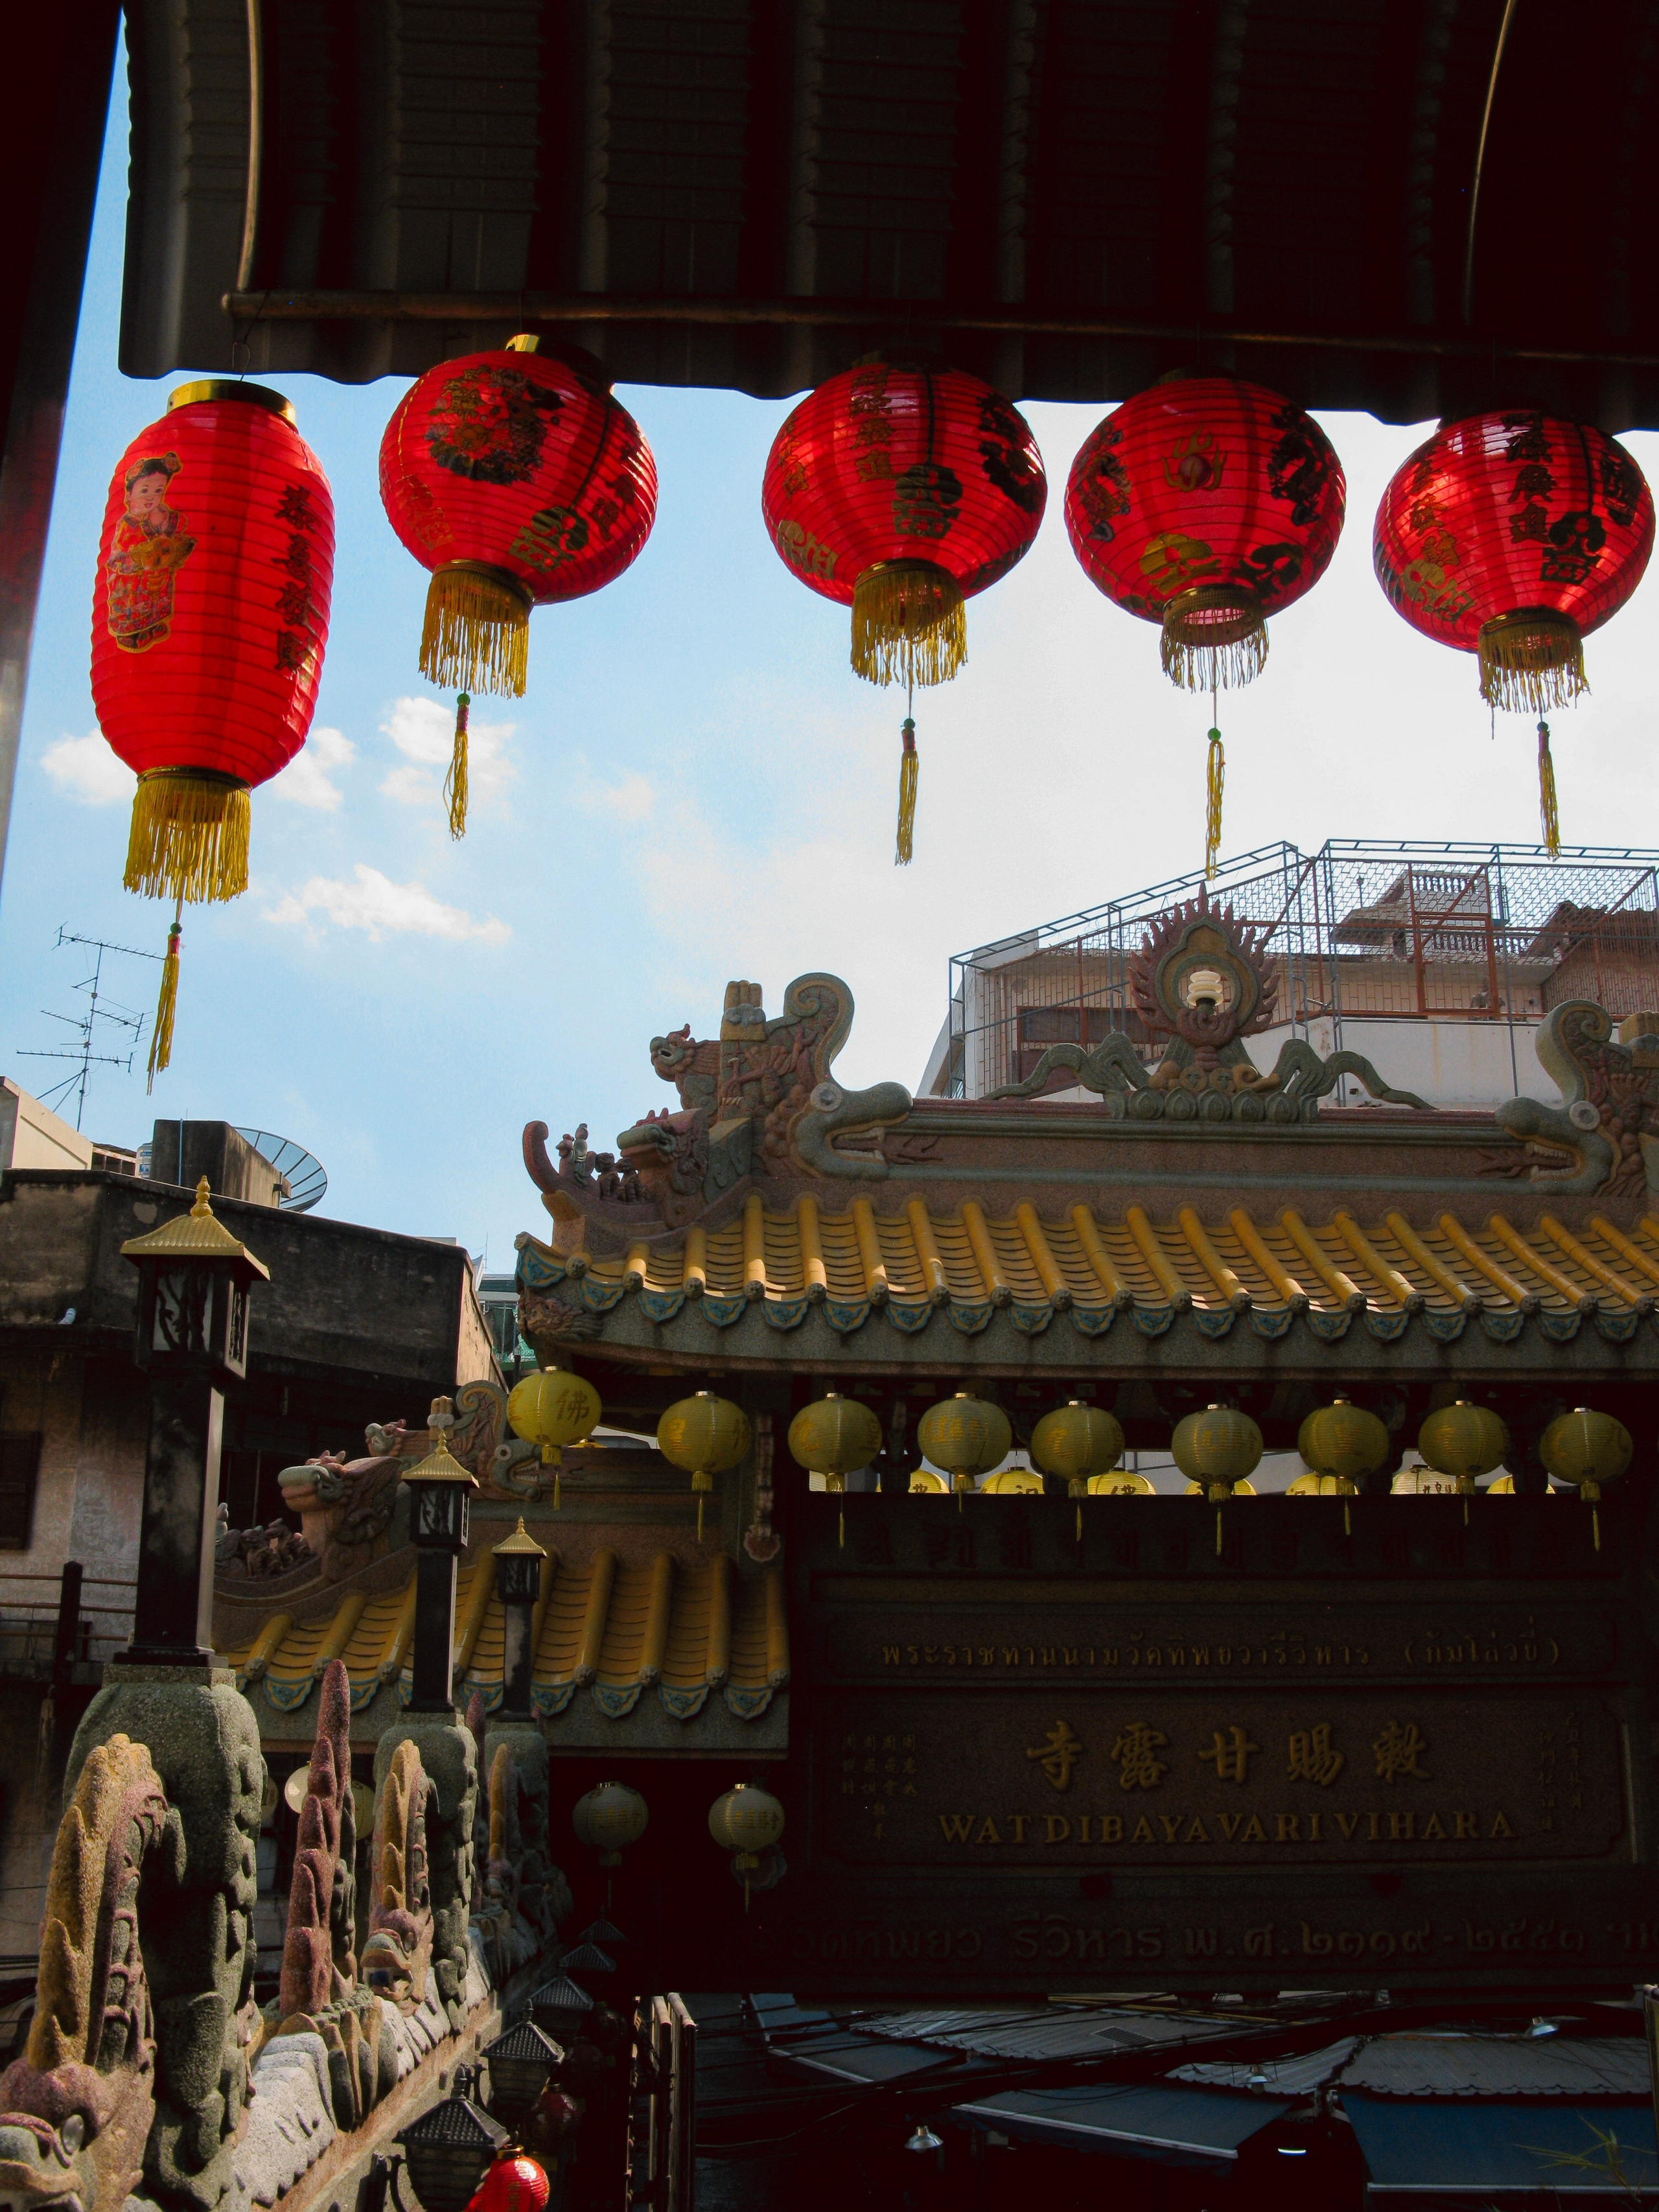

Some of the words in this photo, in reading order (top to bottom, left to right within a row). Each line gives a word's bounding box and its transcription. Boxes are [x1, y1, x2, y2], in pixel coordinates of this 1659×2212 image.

[555, 1388, 590, 1425] 佛
[882, 1631, 1369, 1666] พระราชทานนามวัดทิพยวารีวิหาร
[938, 1813, 1030, 1844] WAT
[1043, 1812, 1322, 1844] DIBAYAVARI
[1333, 1810, 1517, 1841] VIHARA
